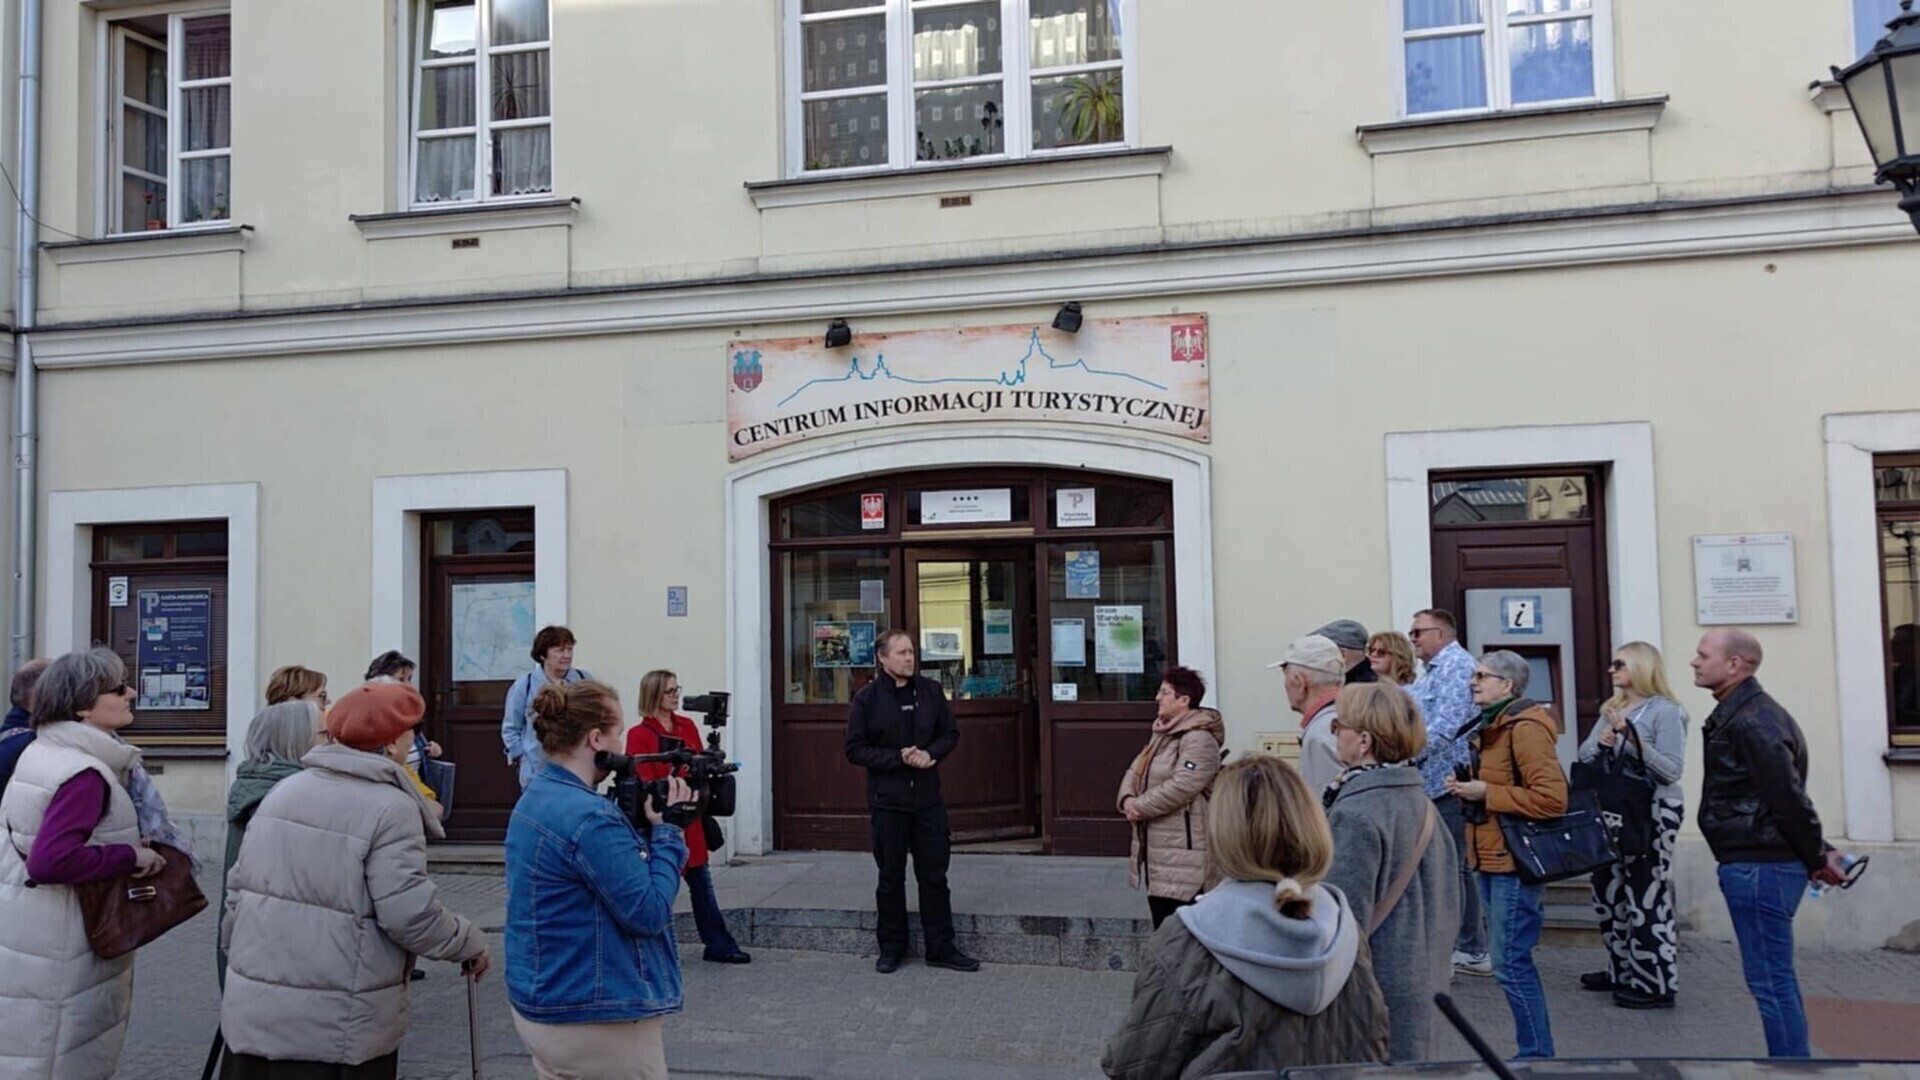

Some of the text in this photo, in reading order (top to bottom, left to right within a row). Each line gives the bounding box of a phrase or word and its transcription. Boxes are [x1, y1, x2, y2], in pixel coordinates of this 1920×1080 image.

[734, 391, 1206, 446] CENTRUM INFORMACJI TURYSTYCZNEJ
